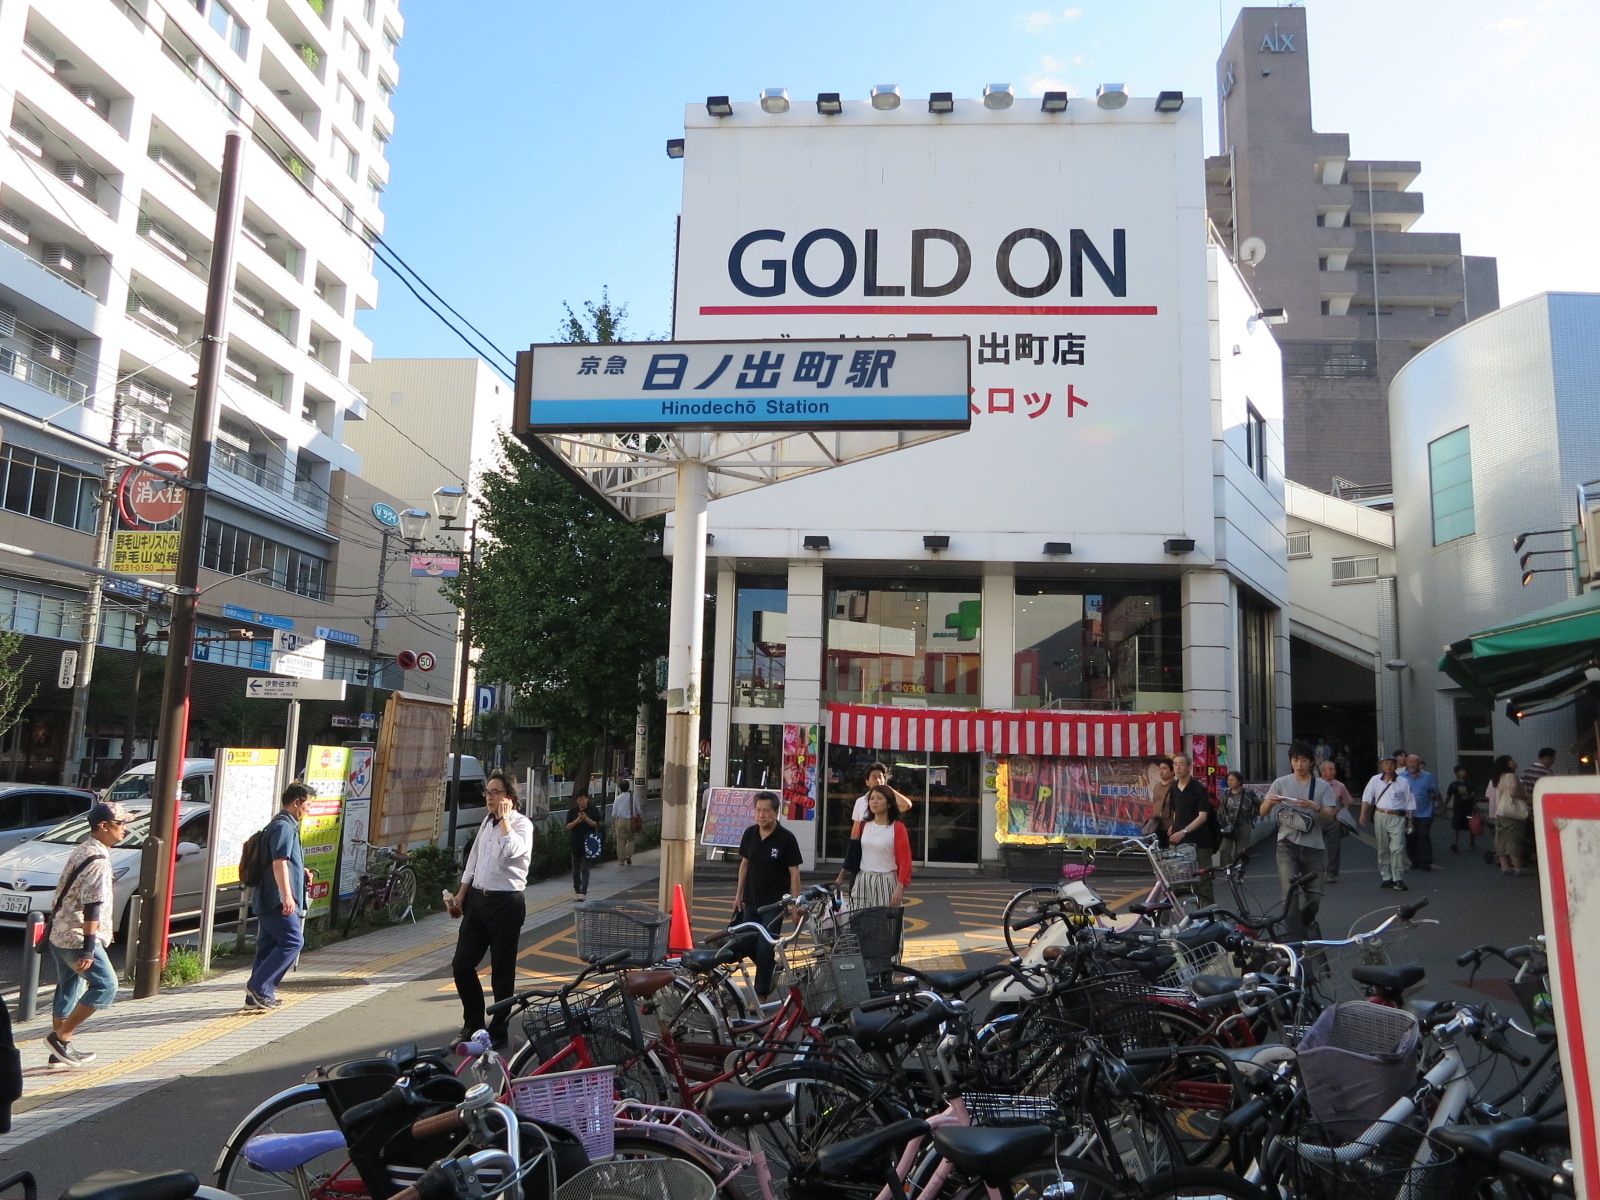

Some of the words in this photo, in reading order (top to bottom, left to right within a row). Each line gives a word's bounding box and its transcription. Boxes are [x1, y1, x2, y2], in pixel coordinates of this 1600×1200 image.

[728, 228, 971, 298] GOLD
[995, 228, 1127, 298] ON
[978, 332, 1087, 365] 出町店
[577, 355, 627, 375] 京急
[642, 350, 897, 390] 日ノ出町駅
[662, 400, 756, 415] Hinodechō
[766, 400, 829, 414] Station
[116, 534, 180, 550] 野毛山キリストの
[120, 564, 154, 572] 231-0150
[420, 657, 432, 667] 50
[6, 902, 27, 912] 30-74
